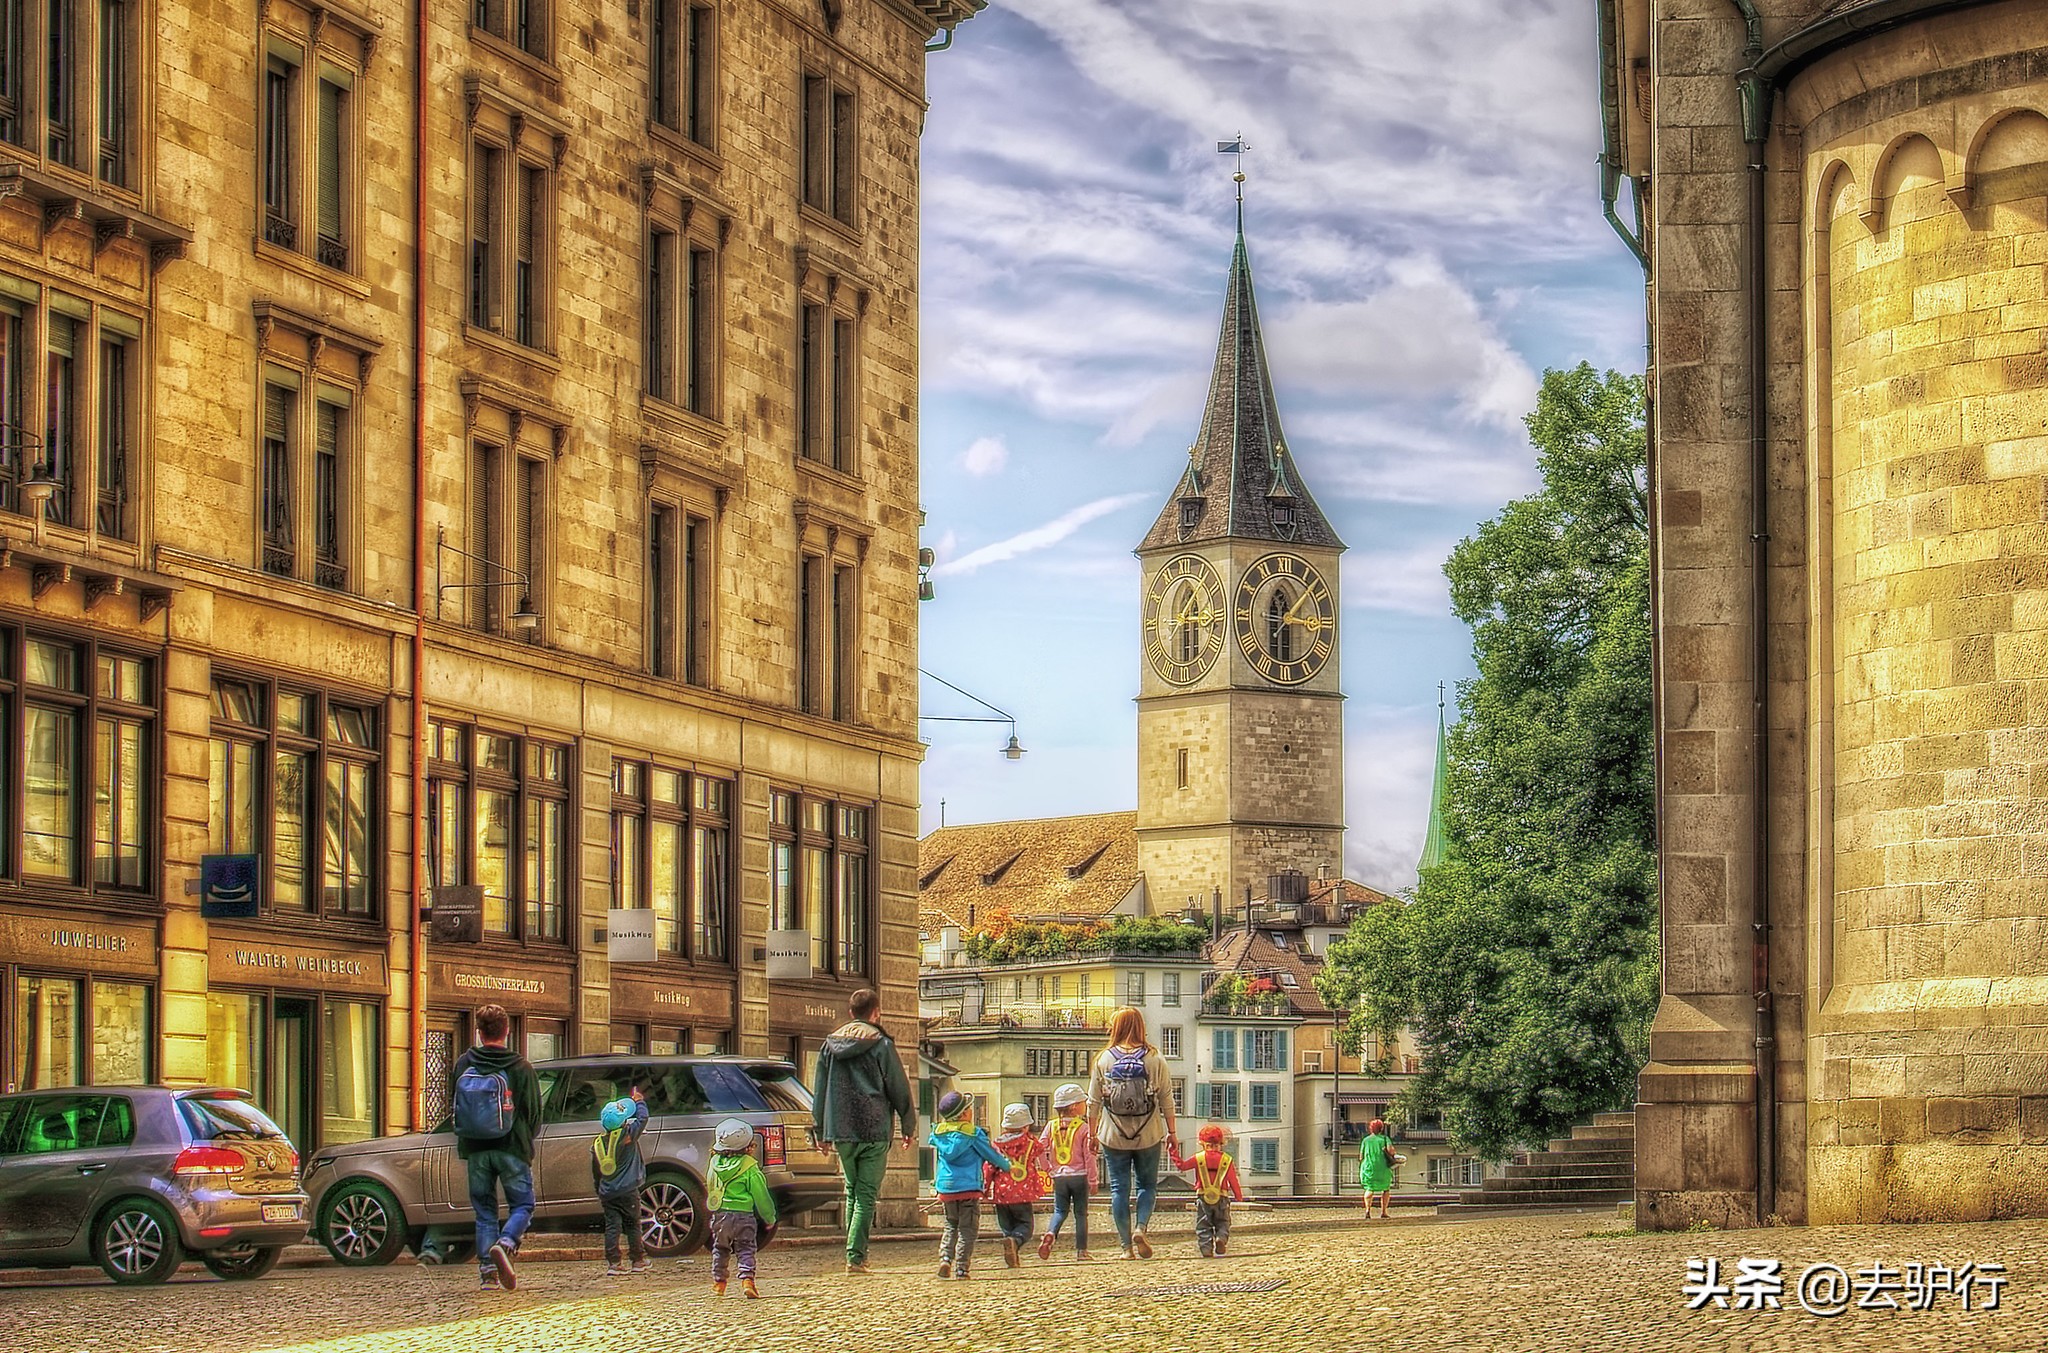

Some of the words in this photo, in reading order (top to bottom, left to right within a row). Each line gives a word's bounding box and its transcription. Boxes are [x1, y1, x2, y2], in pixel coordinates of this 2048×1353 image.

[1278, 558, 1292, 574] XII
[453, 916, 460, 928] 9
[51, 930, 127, 952] JUWELIER
[611, 930, 653, 939] MusikHug
[236, 950, 288, 969] WALTER
[296, 956, 361, 975] WEINBECK
[455, 973, 539, 993] GROSSMÜNSTERPLATZ
[539, 980, 546, 994] 9
[653, 990, 691, 1007] MusikHug
